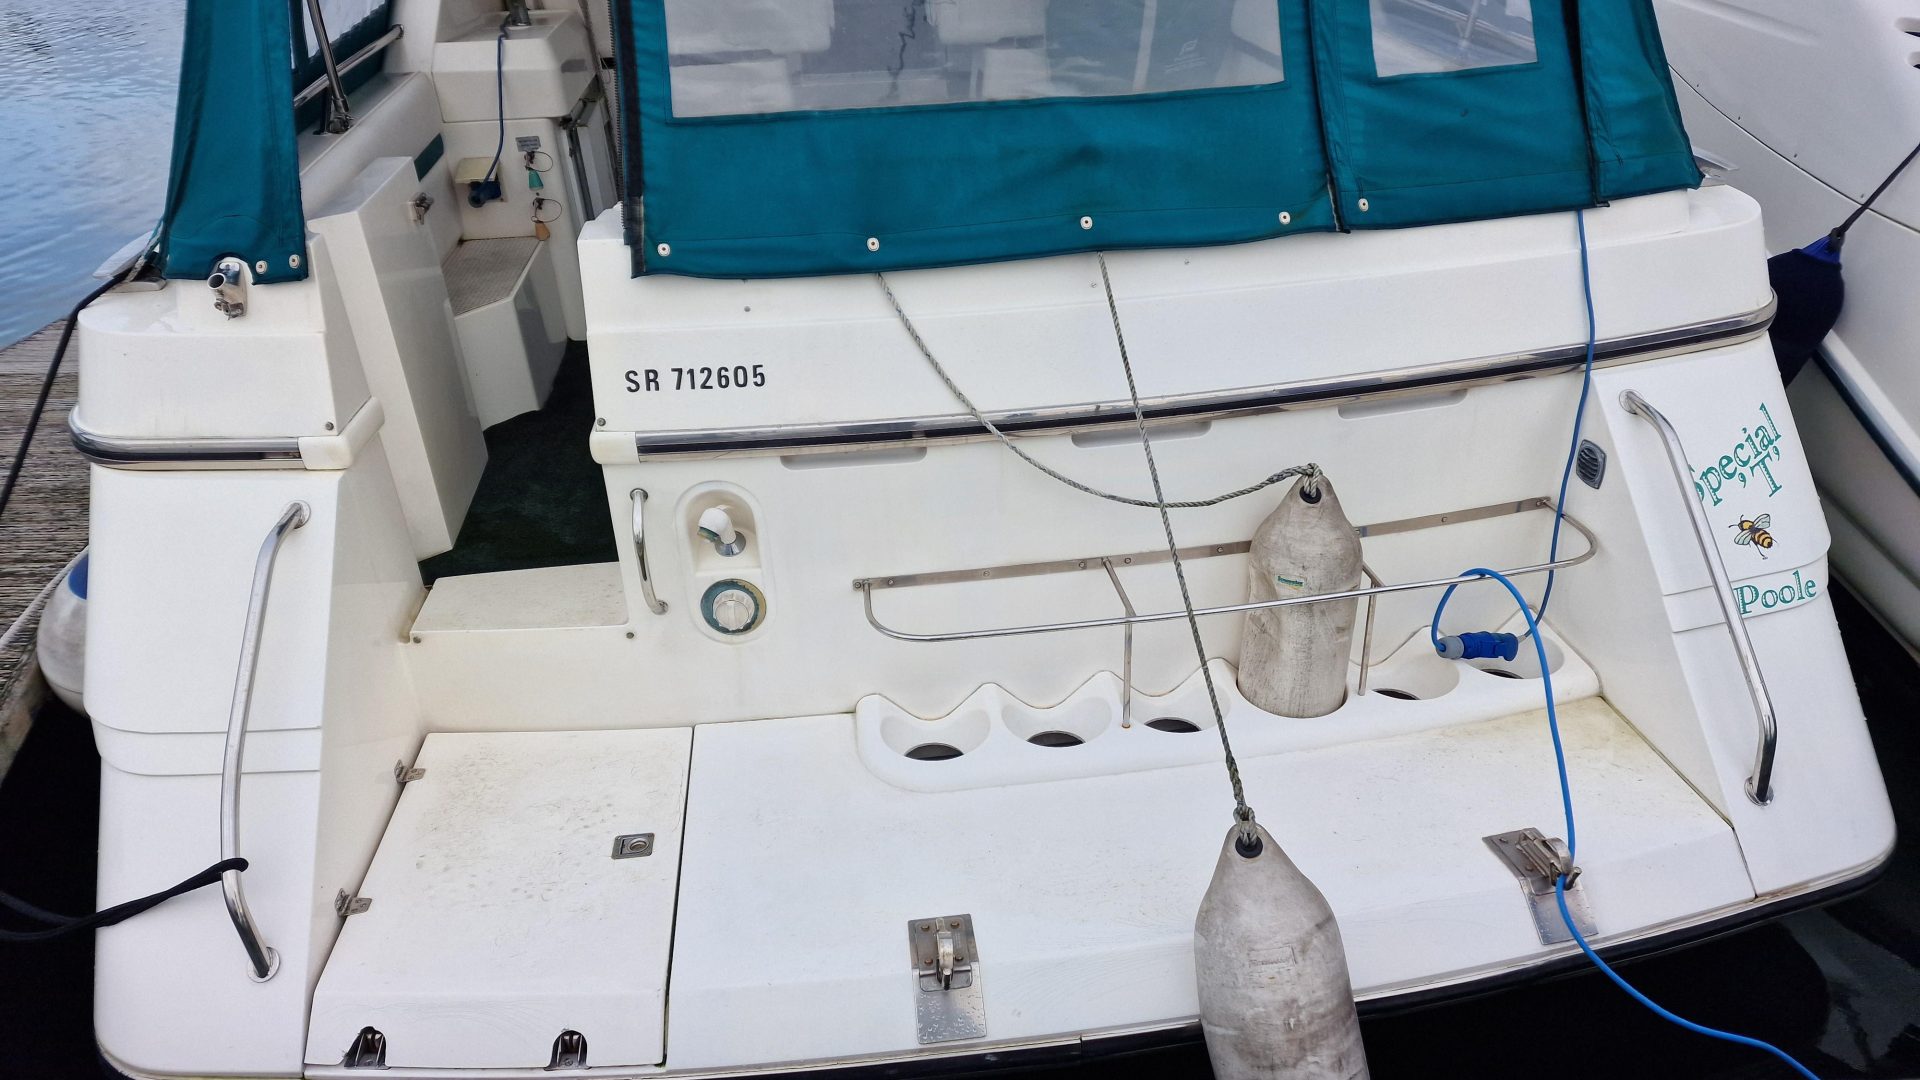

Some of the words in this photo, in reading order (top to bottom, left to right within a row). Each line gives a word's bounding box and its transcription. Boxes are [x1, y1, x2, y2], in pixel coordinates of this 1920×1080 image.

[625, 369, 660, 393] SR
[671, 364, 766, 391] 712605
[1734, 569, 1818, 615] Poole
